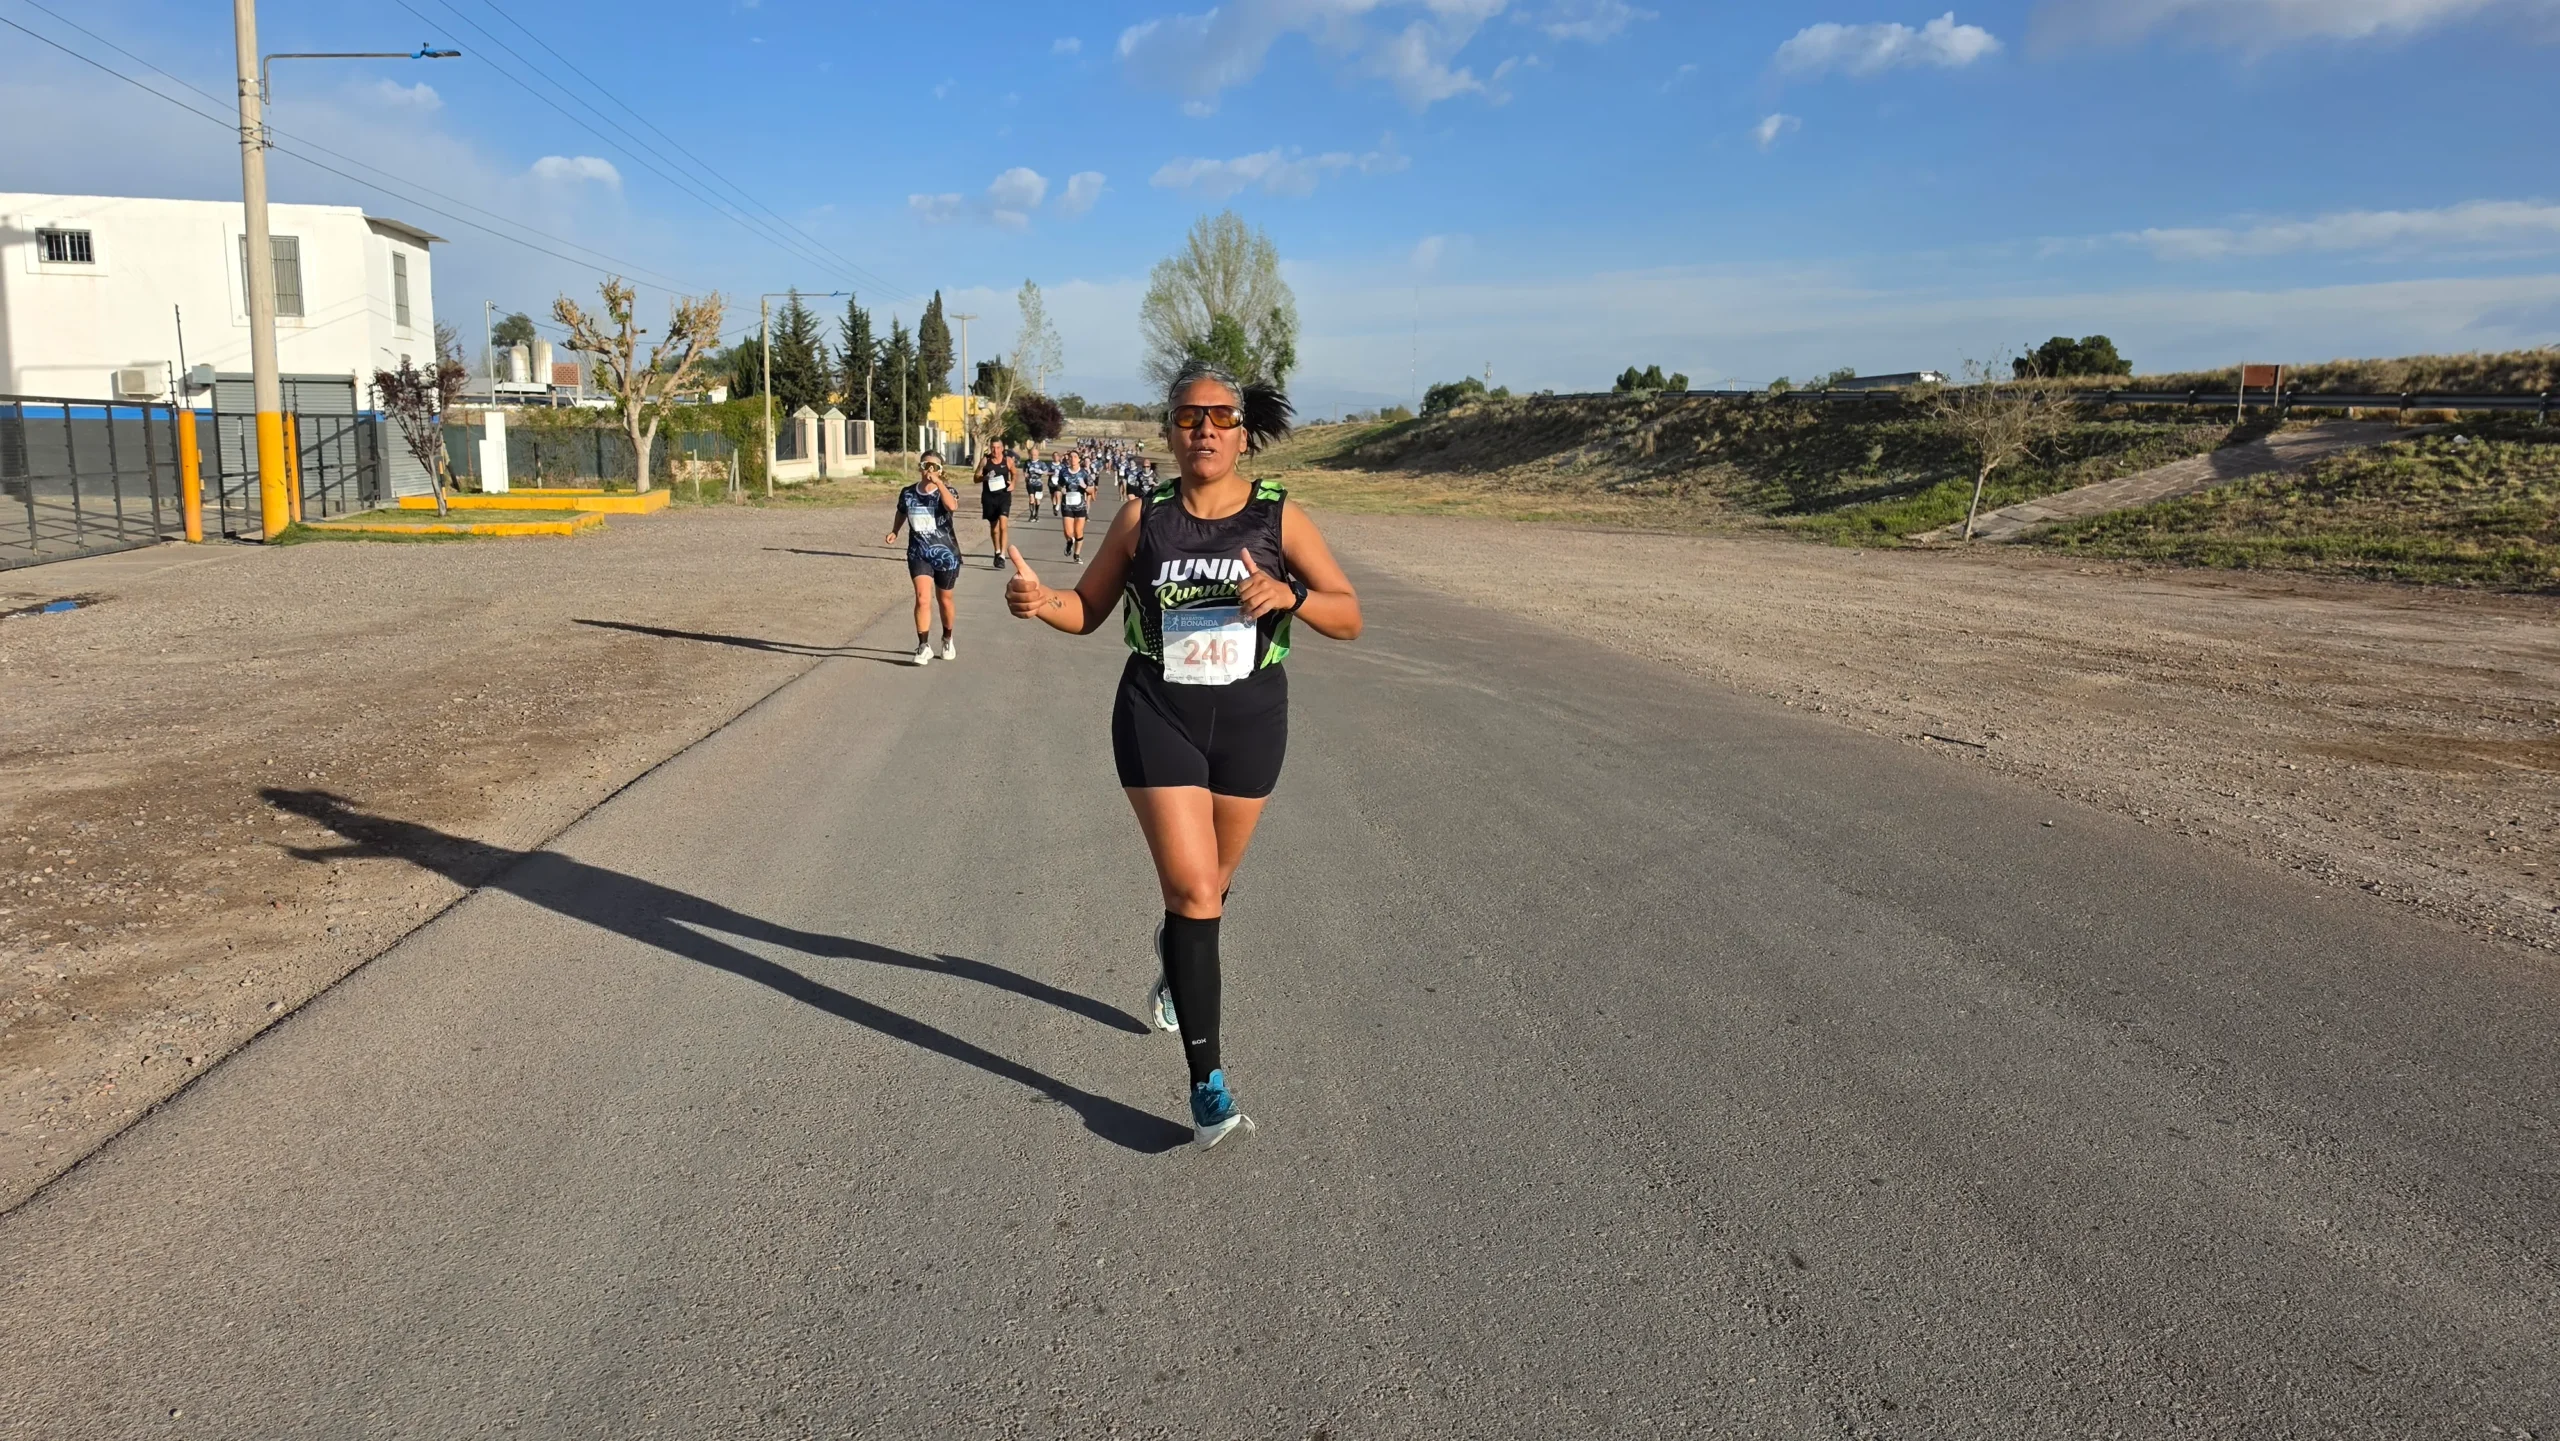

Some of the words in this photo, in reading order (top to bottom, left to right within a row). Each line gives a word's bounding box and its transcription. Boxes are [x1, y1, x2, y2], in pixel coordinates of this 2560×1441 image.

[1151, 559, 1251, 586] JUNIN
[1155, 579, 1243, 610] Runnin
[1181, 619, 1219, 627] BONARDA
[1183, 639, 1239, 665] 246
